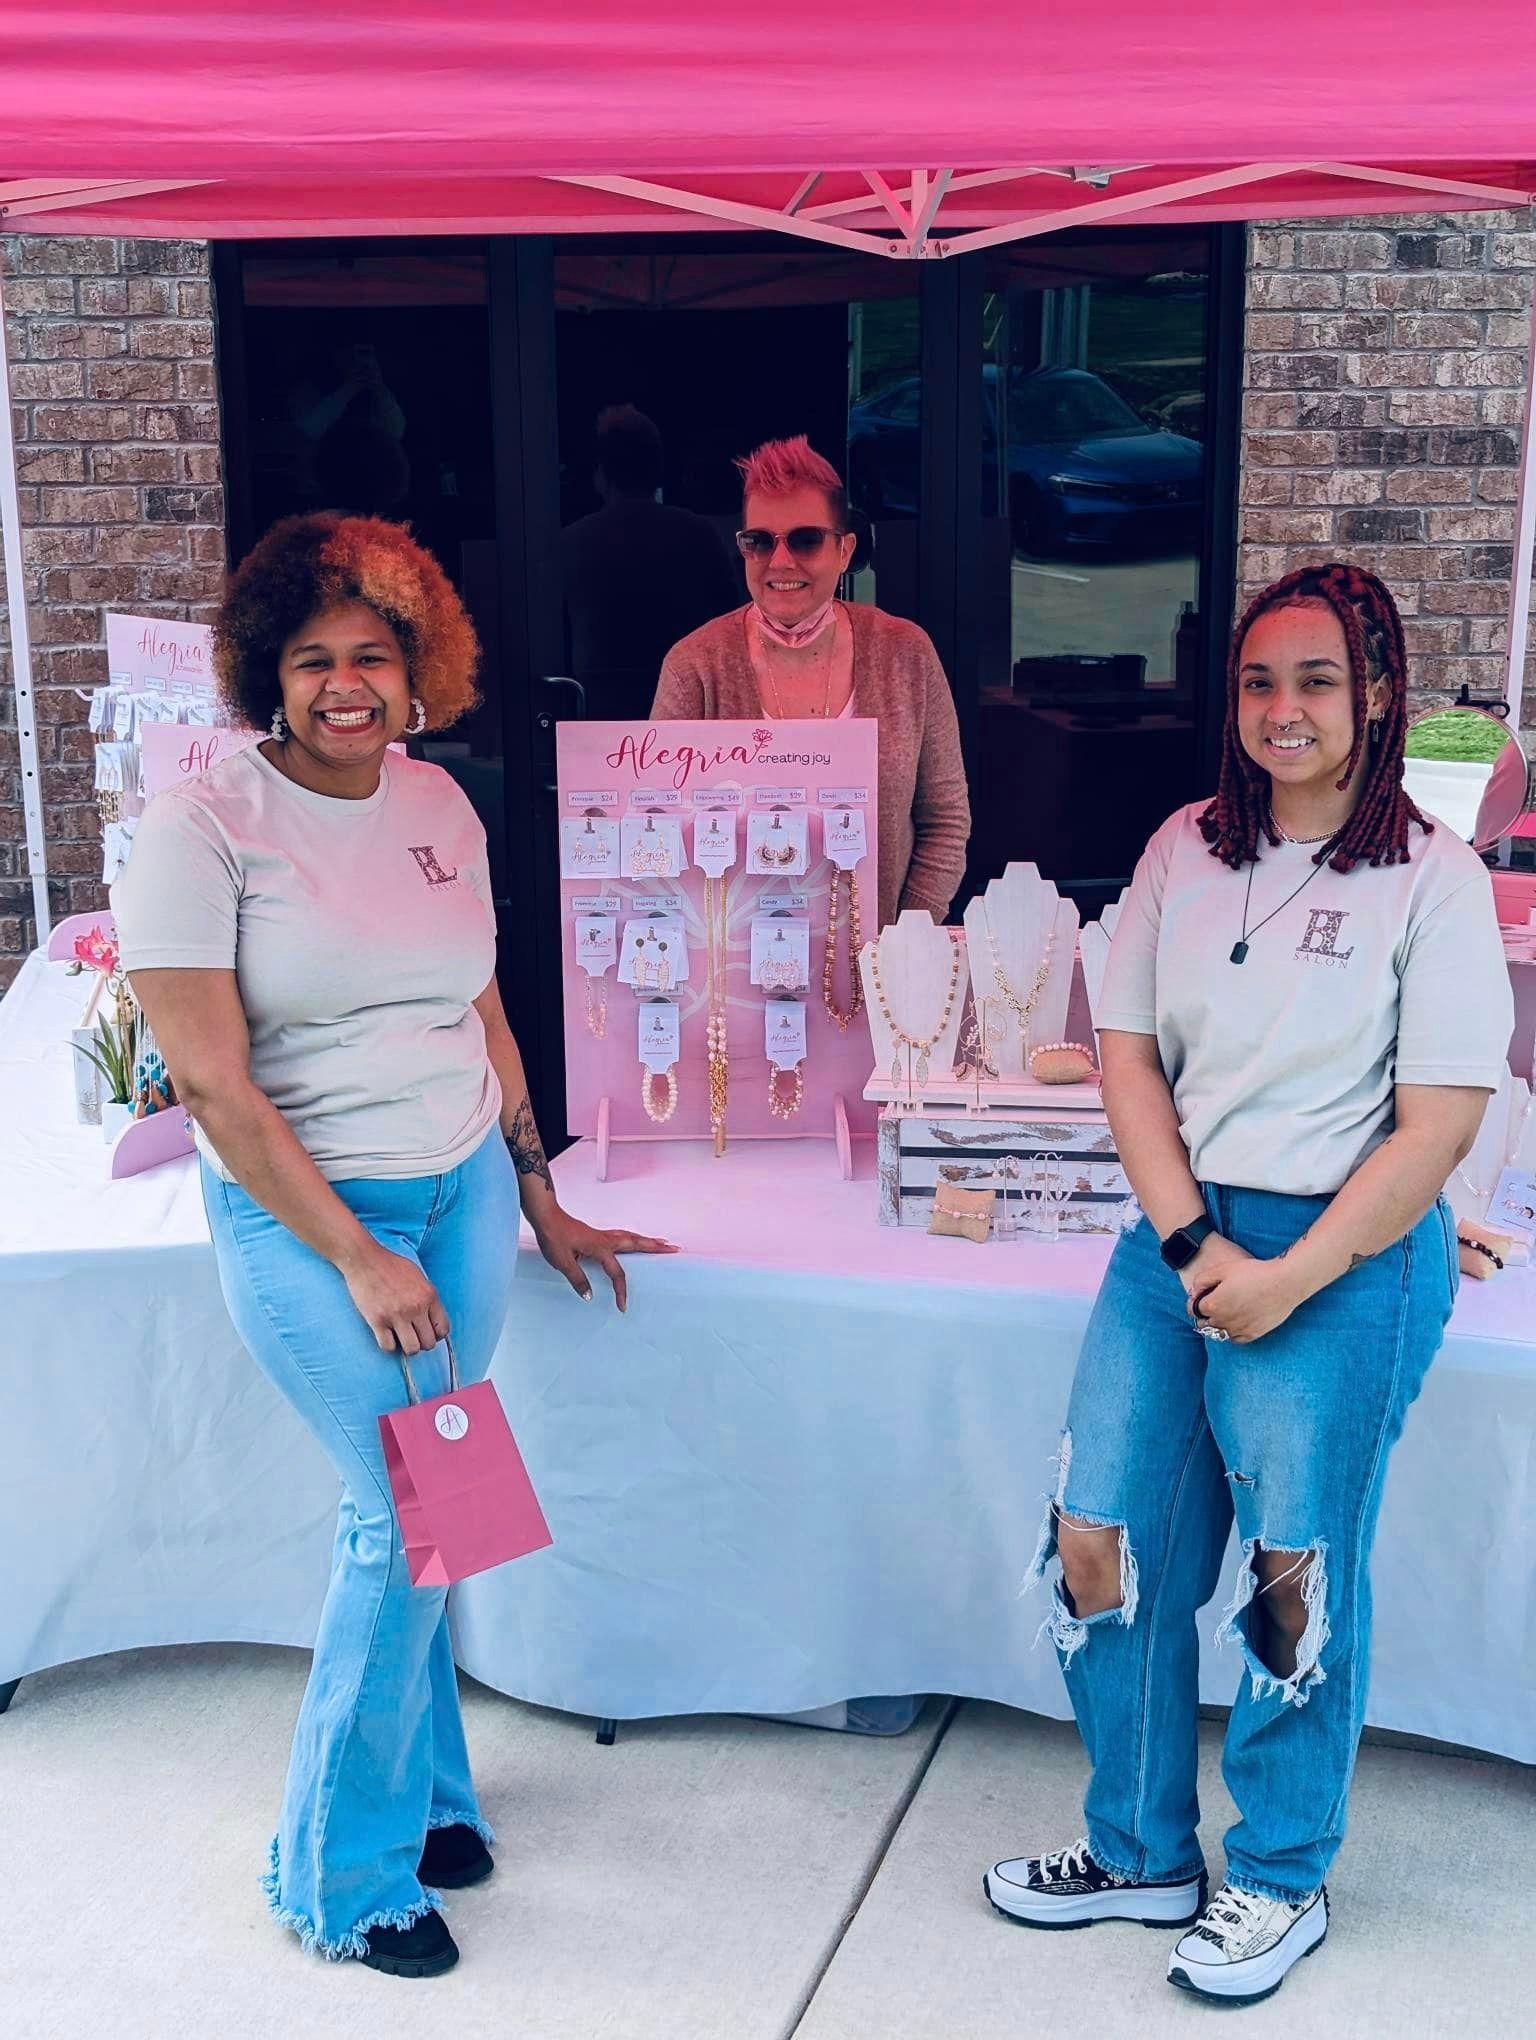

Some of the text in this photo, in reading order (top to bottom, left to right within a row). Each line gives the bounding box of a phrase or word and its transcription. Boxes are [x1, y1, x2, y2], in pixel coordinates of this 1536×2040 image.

[137, 624, 203, 676] Alegria
[606, 728, 755, 789] Alegria
[758, 752, 831, 765] creating joy
[1293, 952, 1348, 968] SALON
[440, 1407, 464, 1434] A
